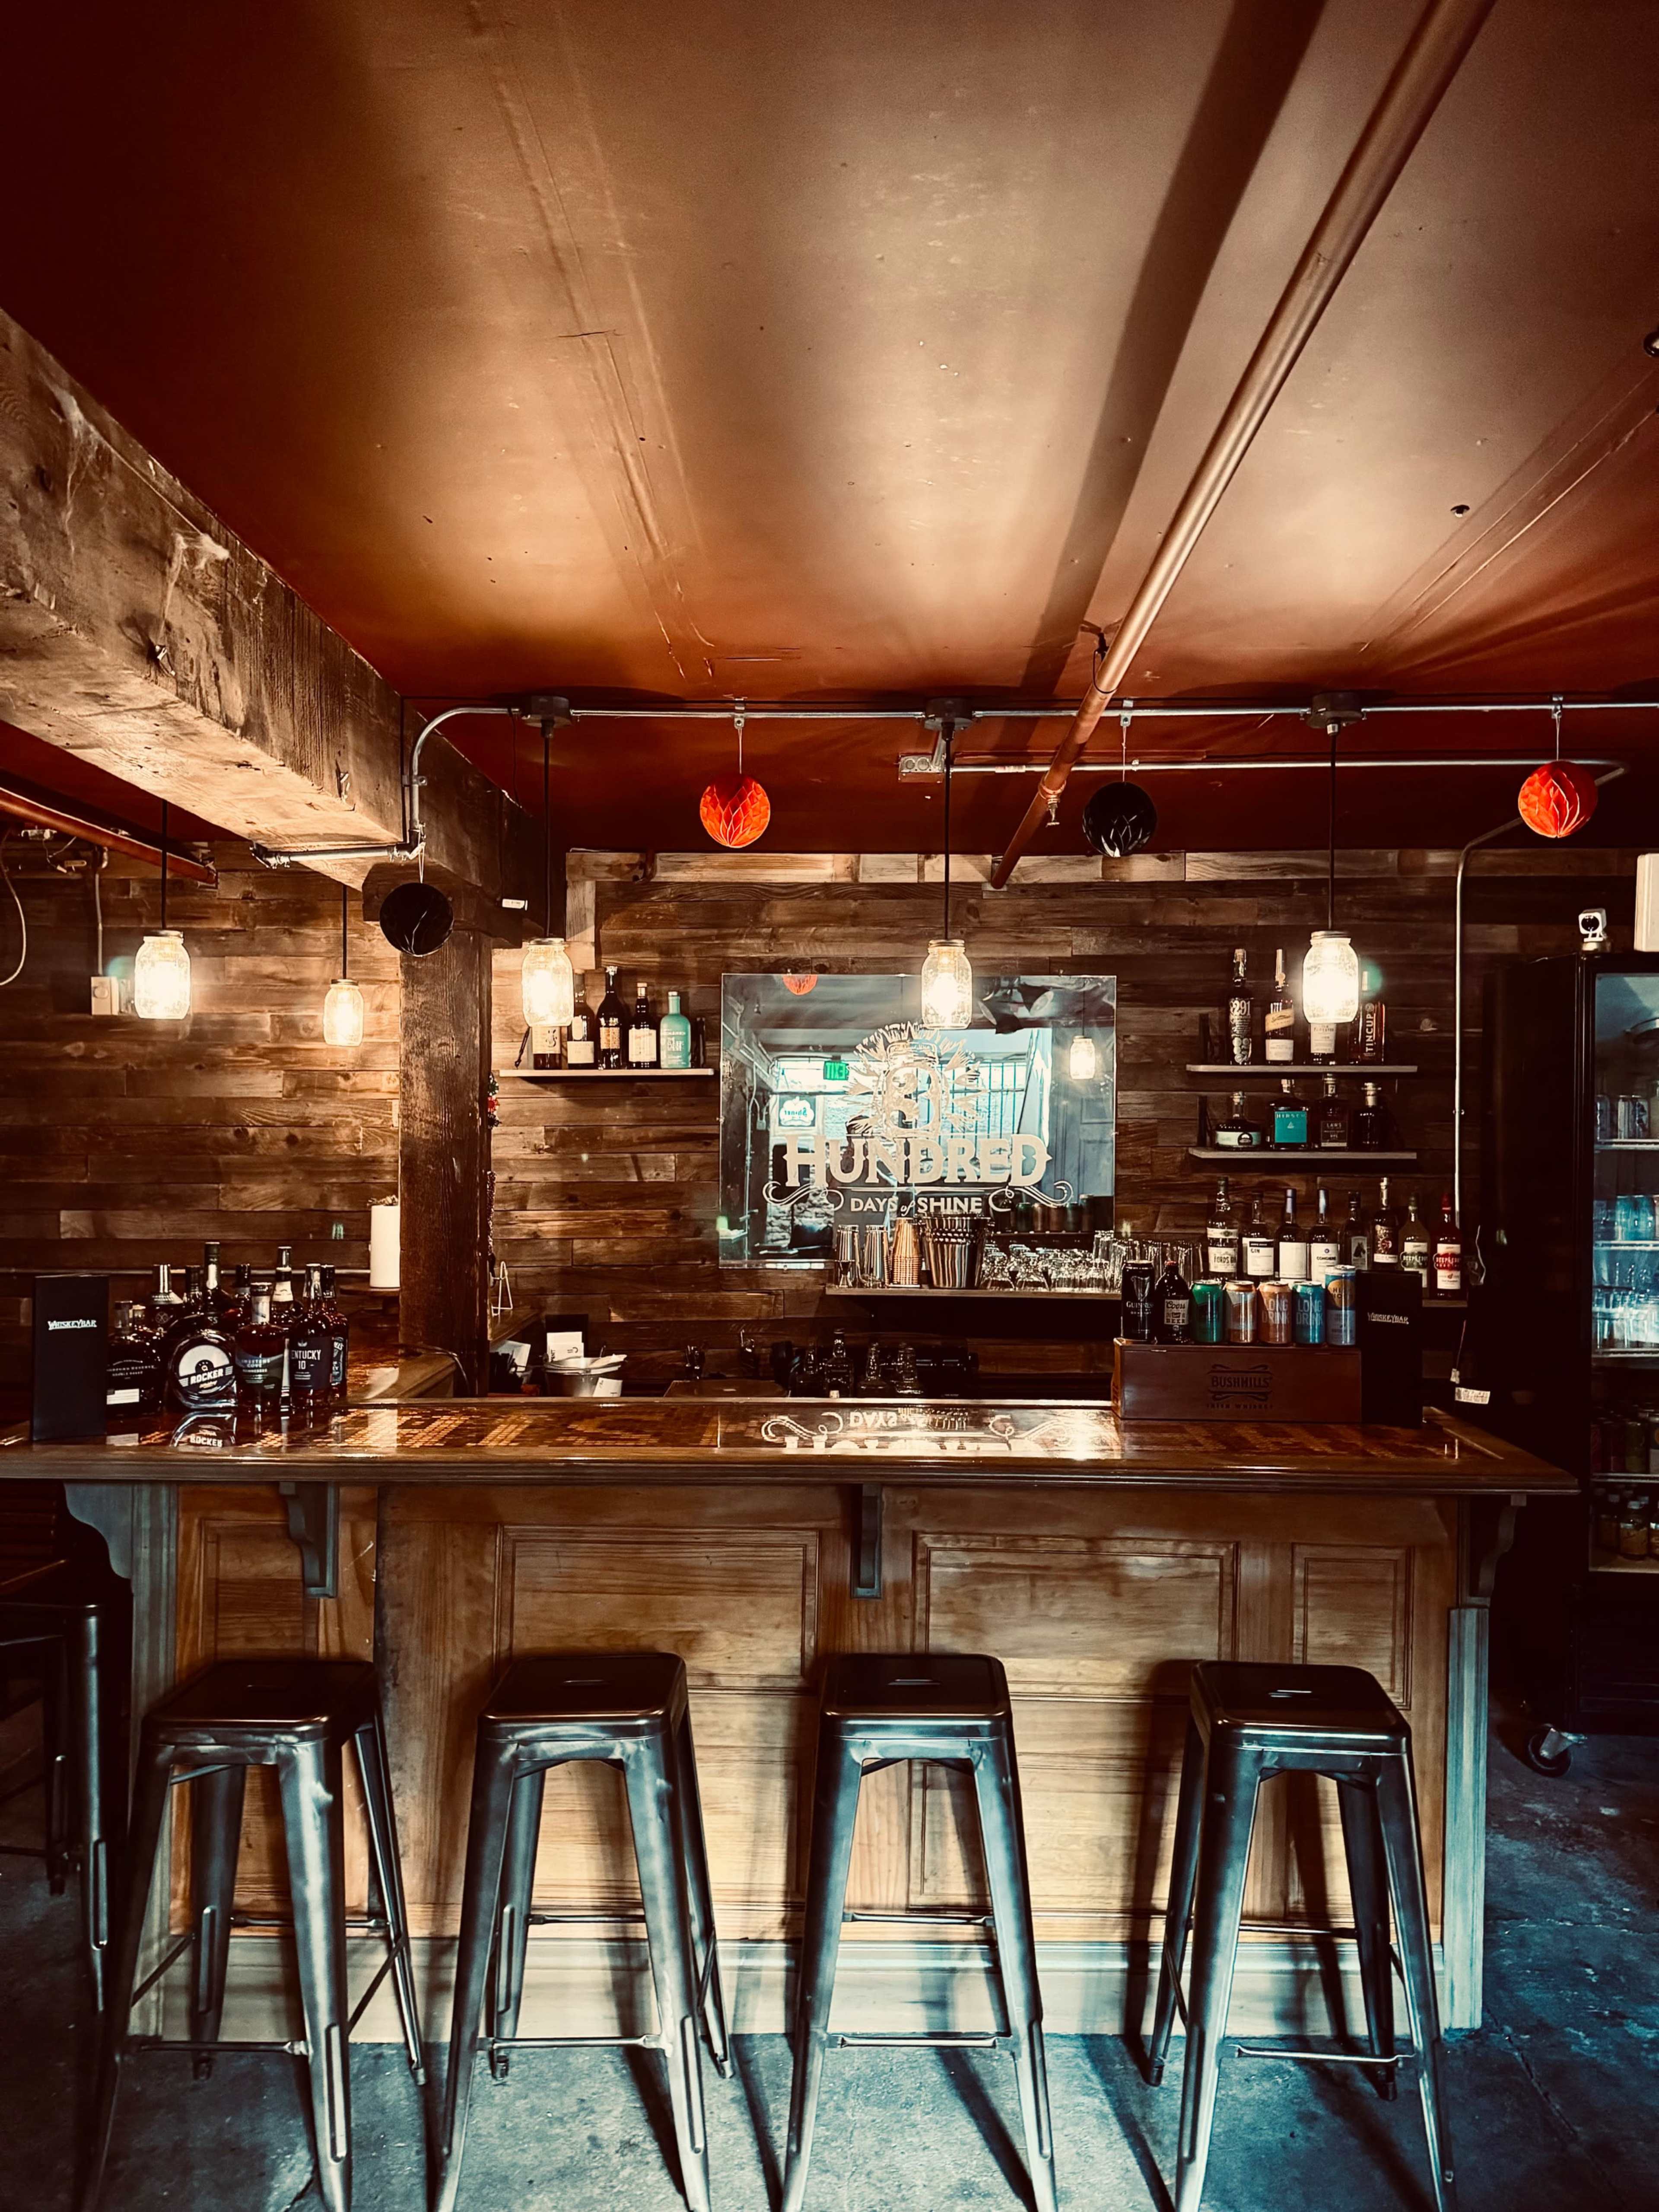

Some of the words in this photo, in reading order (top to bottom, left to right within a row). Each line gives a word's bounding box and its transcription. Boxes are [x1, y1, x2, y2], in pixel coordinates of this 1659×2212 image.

[1233, 1000, 1251, 1015] 291
[1366, 1014, 1374, 1052] TINCUP
[782, 1134, 1052, 1187] HUNDRED
[850, 1197, 897, 1212] DAYS
[917, 1197, 982, 1213] SHINE
[1298, 1299, 1322, 1312] LONG
[1297, 1312, 1323, 1325] DRINK
[292, 1349, 321, 1361] ENTUCKY
[298, 1360, 306, 1370] 10
[191, 1368, 223, 1385] ROCKER
[1212, 1375, 1270, 1388] BUSHMILLS
